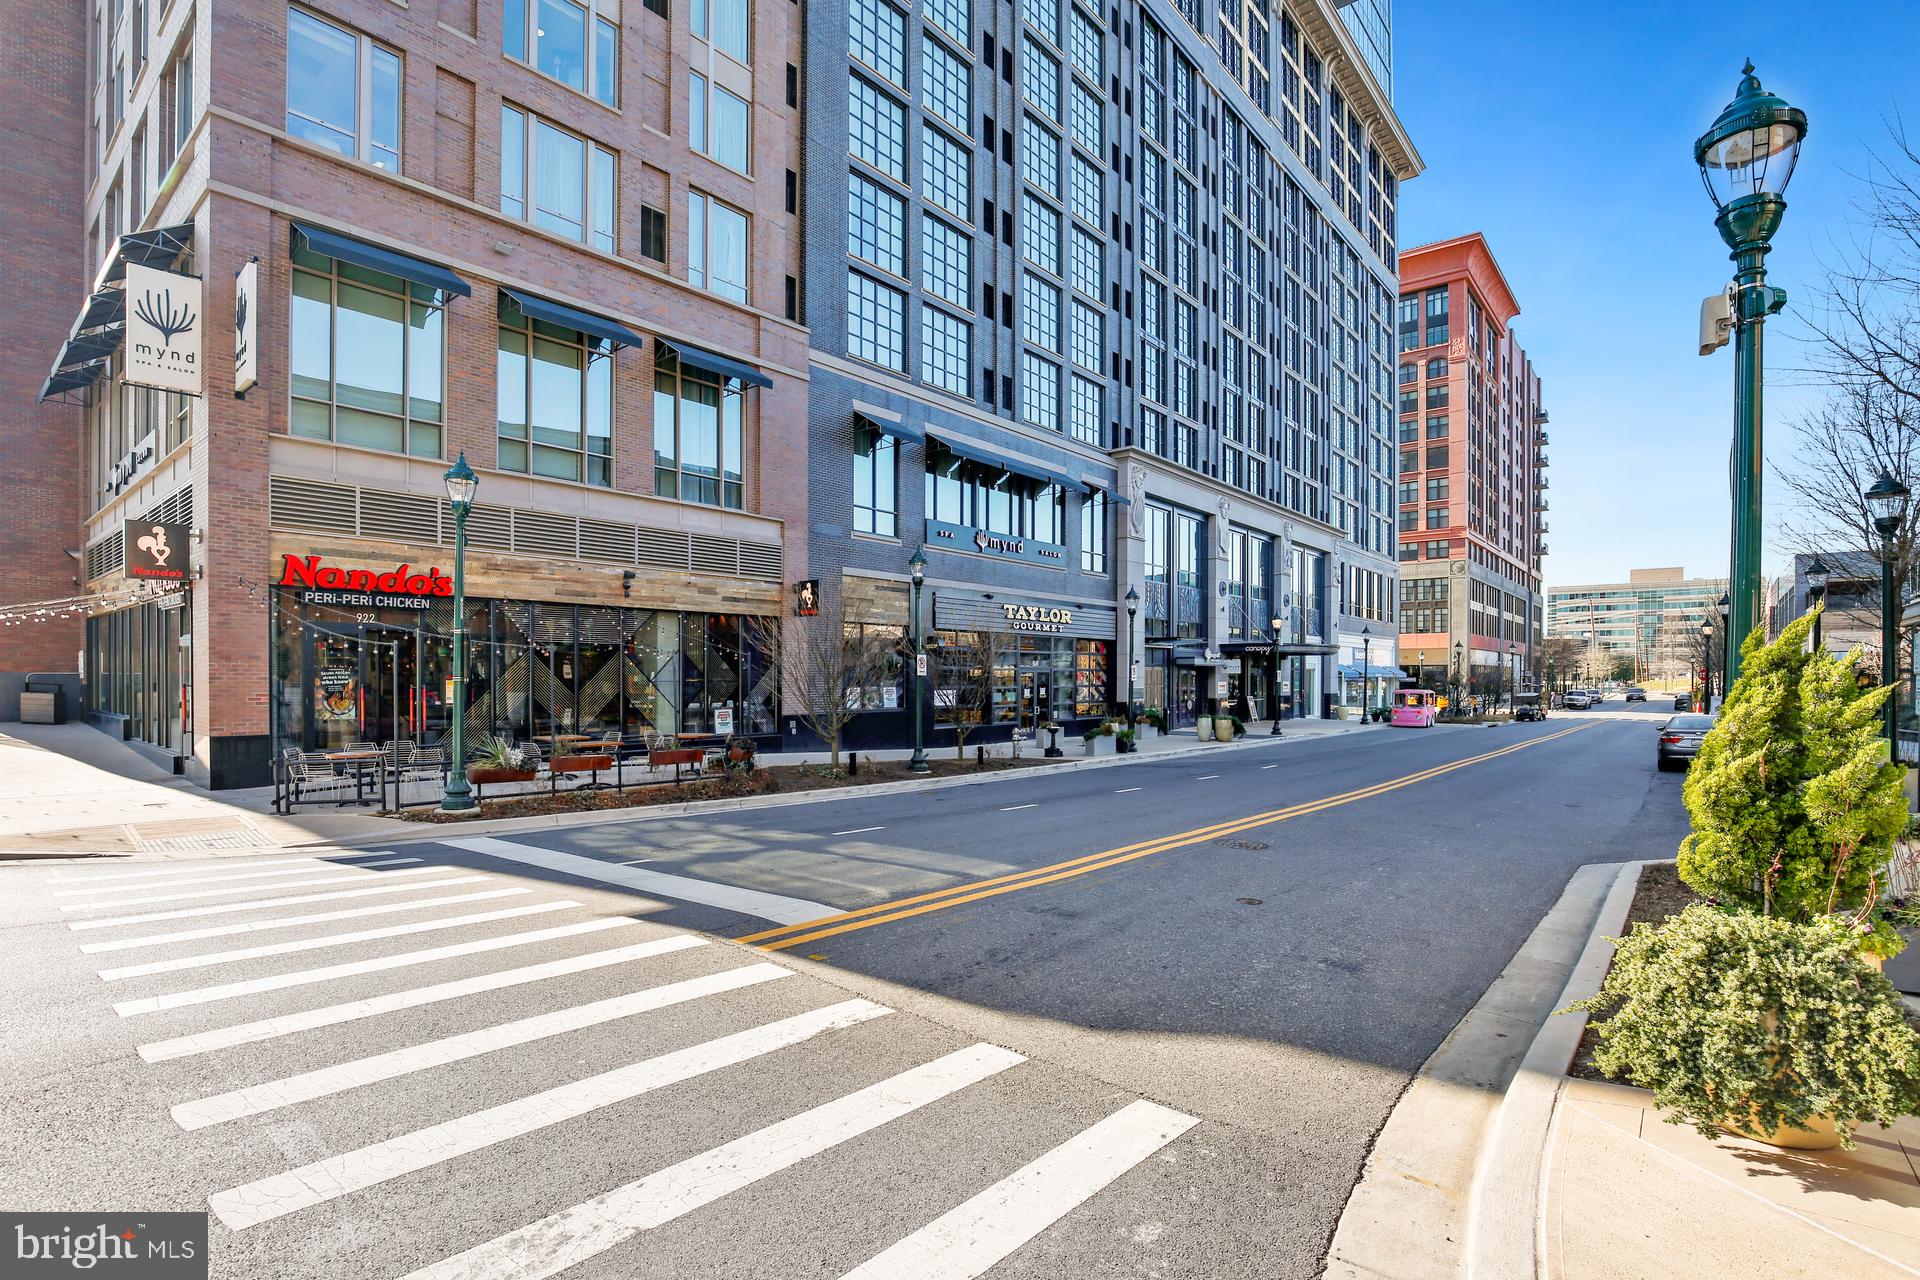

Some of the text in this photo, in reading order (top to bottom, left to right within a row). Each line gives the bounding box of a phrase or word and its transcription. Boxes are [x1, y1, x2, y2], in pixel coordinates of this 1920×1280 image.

[135, 343, 195, 364] mynd
[167, 365, 195, 374] SALON
[939, 530, 1062, 558] SPA mynd SALON
[134, 567, 184, 578] Nando's
[279, 553, 453, 597] Nando's
[305, 591, 431, 609] PERi-PERi CHICKEN
[355, 613, 376, 623] 922
[1003, 603, 1073, 624] TAYLOR
[1013, 621, 1065, 633] GOURMET
[1245, 645, 1275, 656] canopy
